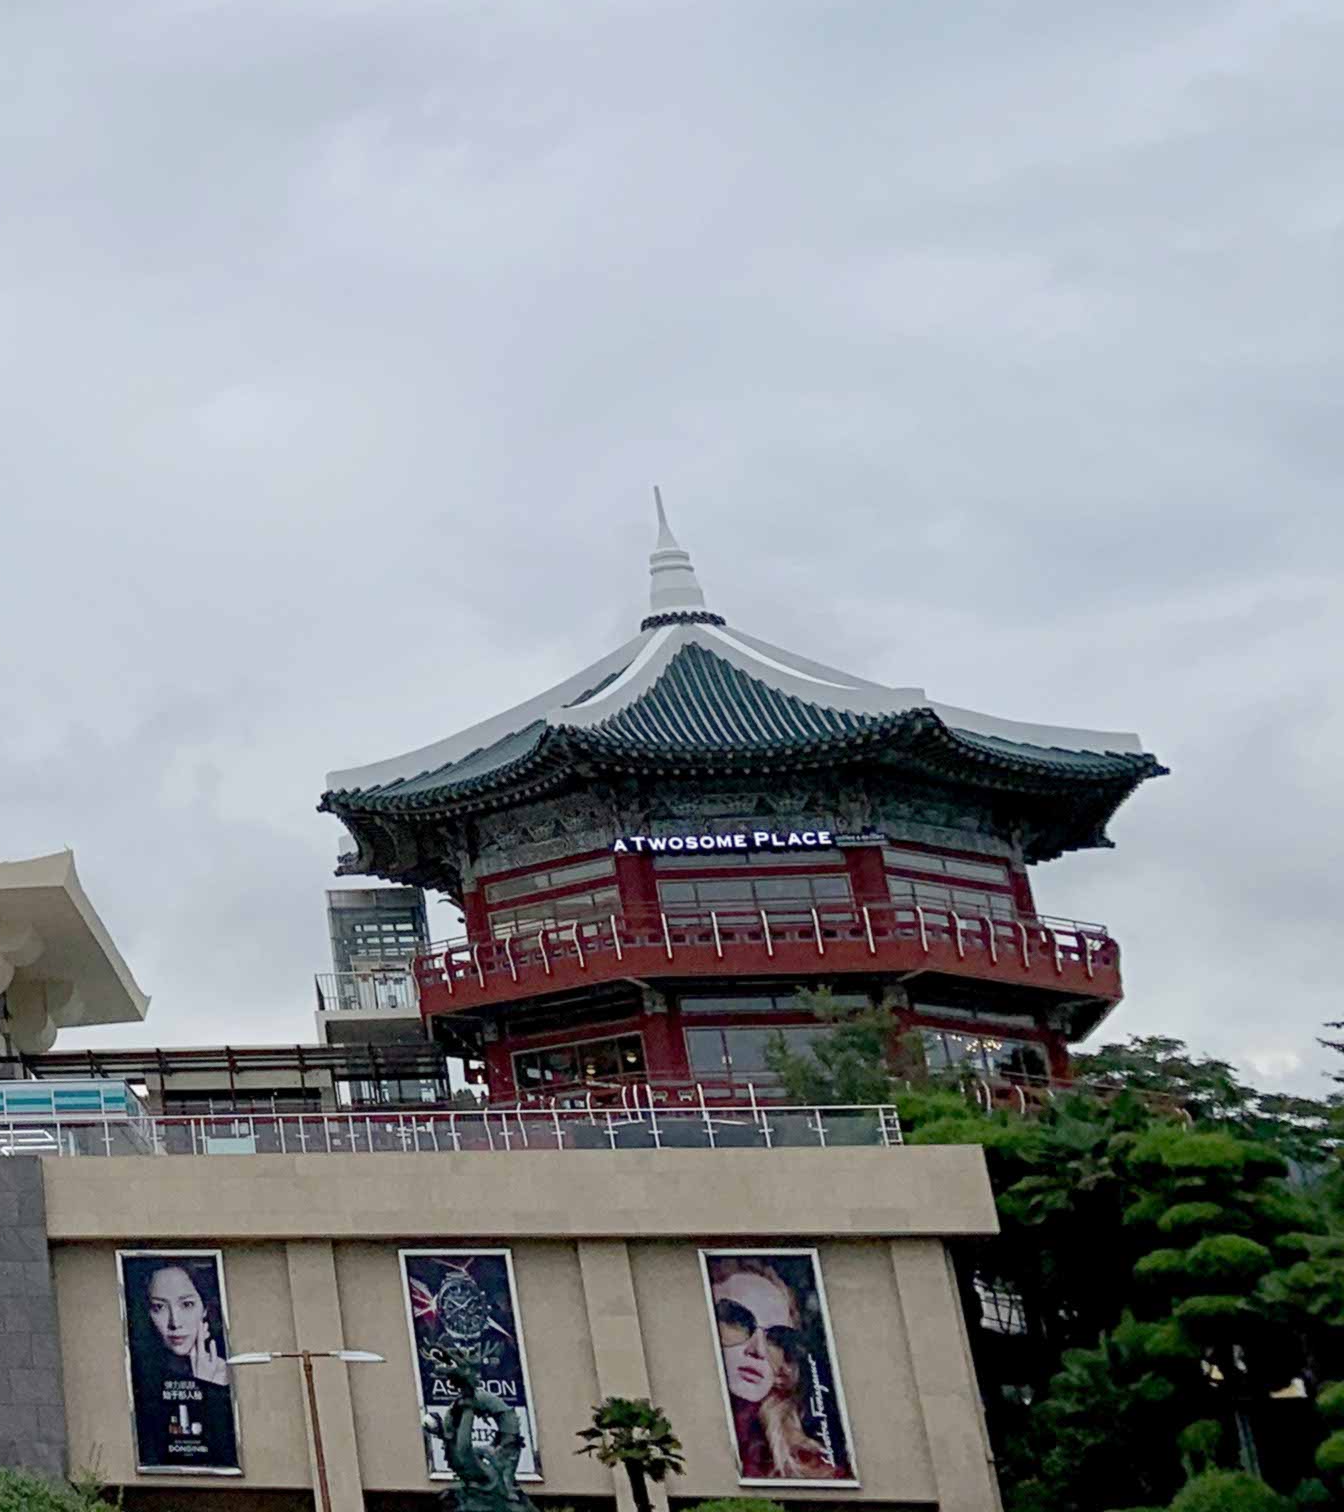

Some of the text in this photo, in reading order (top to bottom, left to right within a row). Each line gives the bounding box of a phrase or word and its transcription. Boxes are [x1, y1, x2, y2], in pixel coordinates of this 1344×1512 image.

[613, 839, 627, 853] A
[631, 835, 747, 851] TWOSOME
[753, 831, 832, 847] PLACE
[433, 1379, 516, 1396] ASRON
